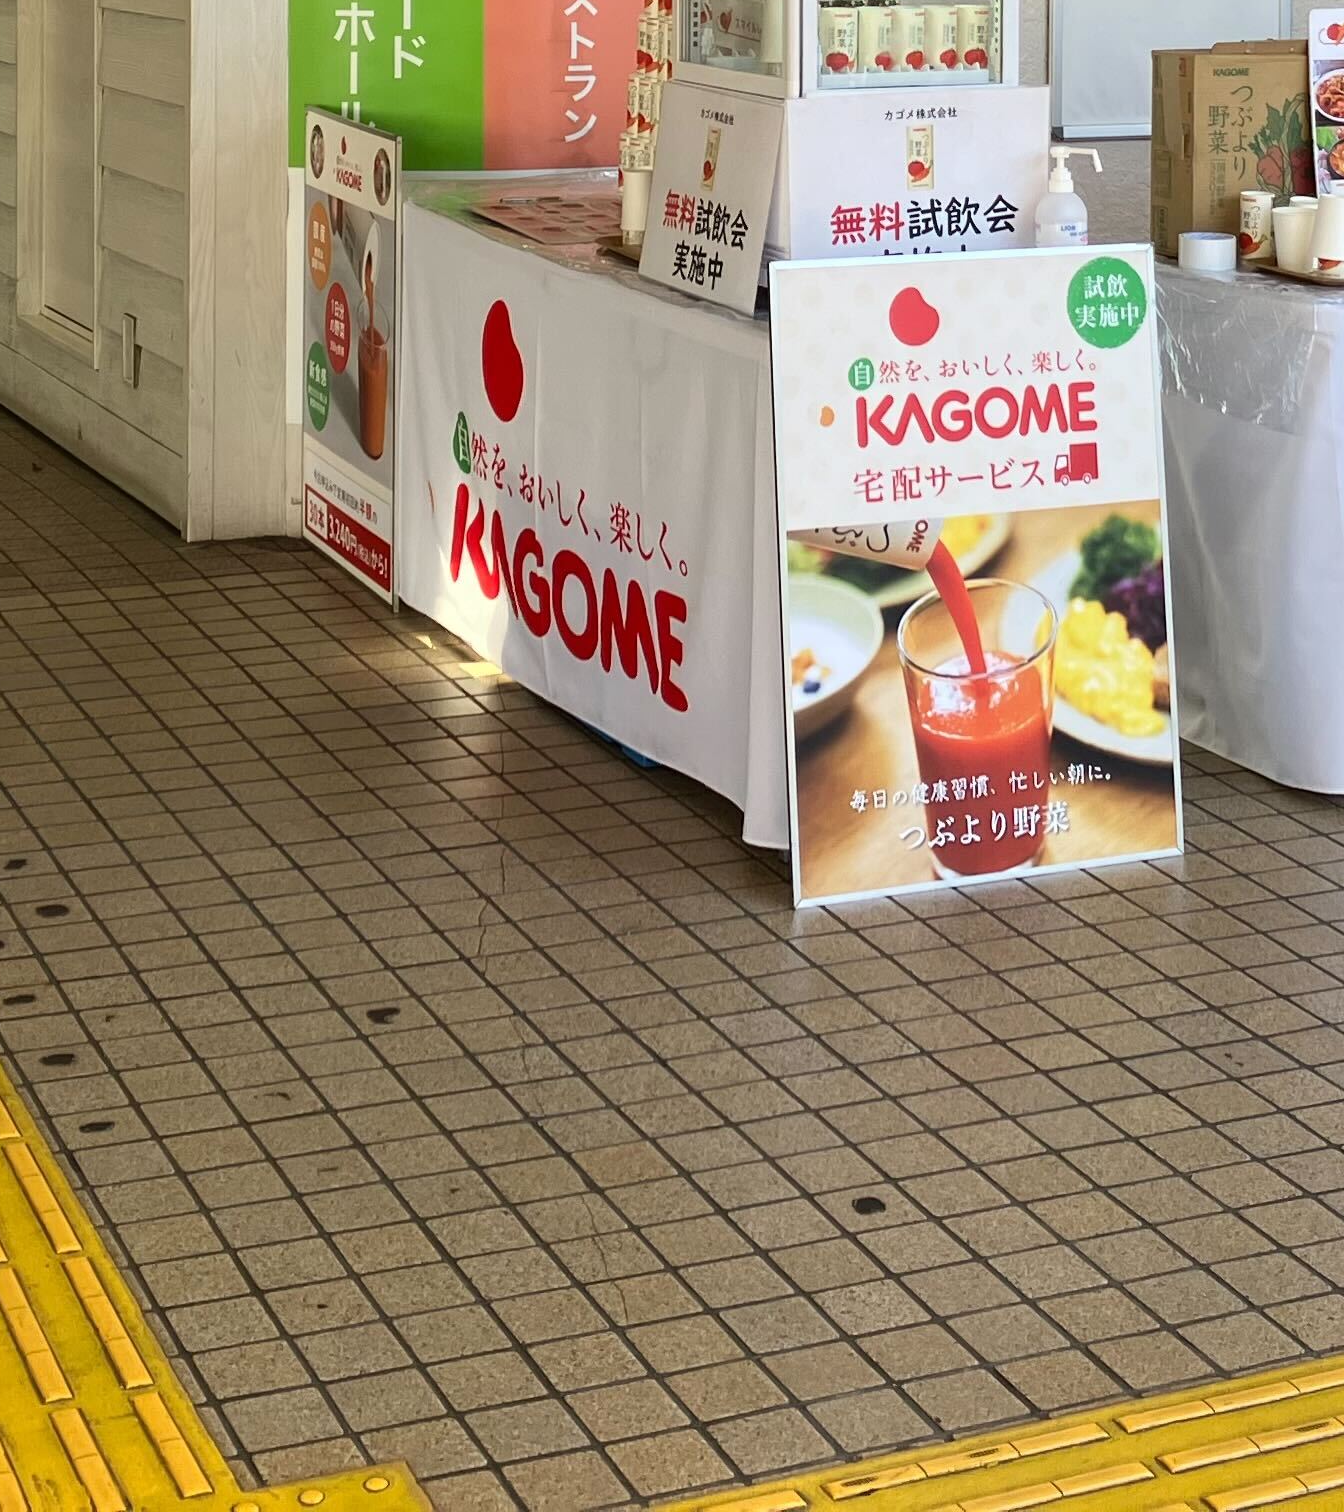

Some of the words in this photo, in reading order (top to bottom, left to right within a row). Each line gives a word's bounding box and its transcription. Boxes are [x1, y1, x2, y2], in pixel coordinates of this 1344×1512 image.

[1213, 67, 1250, 78] KAGOME
[884, 107, 958, 121] カゴメ株式会社
[1208, 105, 1230, 155] 野菜
[1230, 84, 1254, 181] つぶより
[663, 188, 749, 253] 無料試飲会
[830, 194, 1020, 246] 無料試飲会
[672, 242, 724, 292] 実施中
[1083, 273, 1128, 301] 試飲
[1074, 302, 1140, 329] 実施中
[853, 350, 1097, 389] 自然を、おいしく、楽しく。
[855, 381, 1098, 448] KAGOME
[455, 414, 688, 578] 自然を、おいしく、楽しく。
[853, 458, 1044, 503] 宅配サービス
[449, 482, 690, 713] KAGOME
[898, 800, 1070, 851] つぶより野菜
